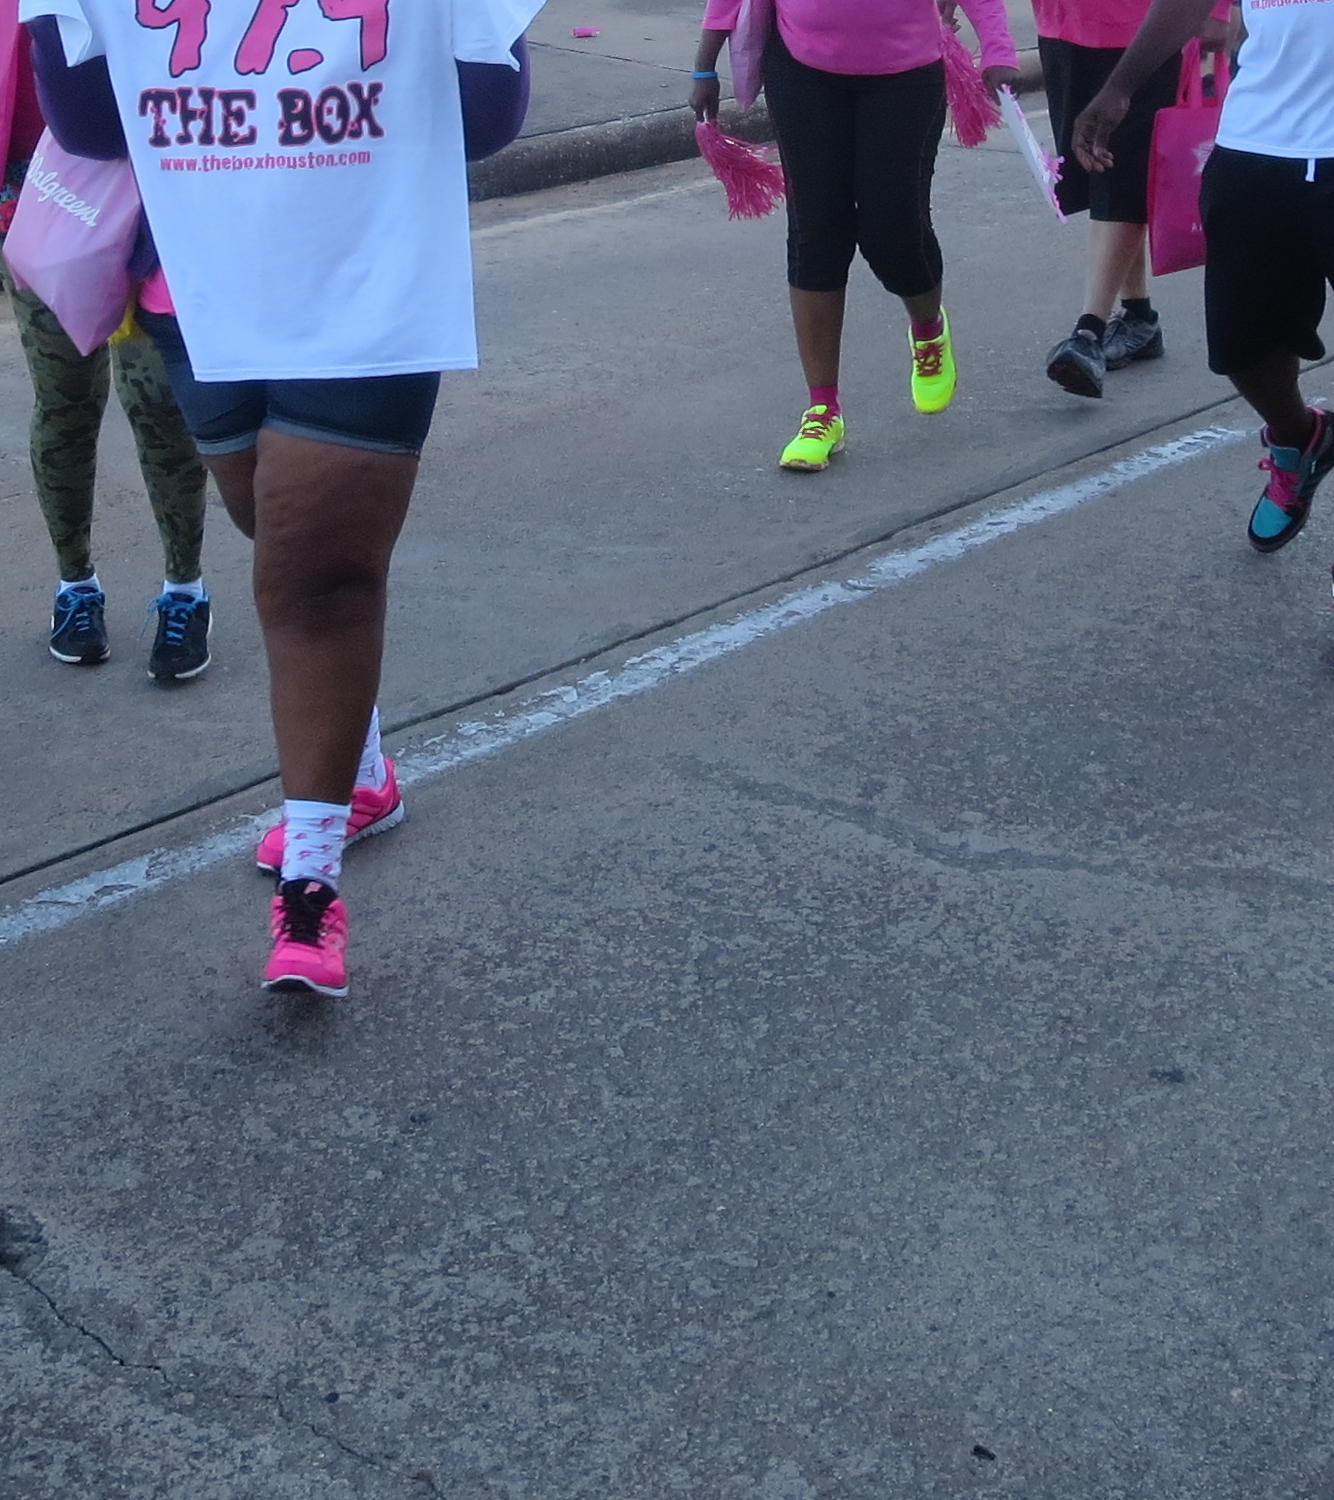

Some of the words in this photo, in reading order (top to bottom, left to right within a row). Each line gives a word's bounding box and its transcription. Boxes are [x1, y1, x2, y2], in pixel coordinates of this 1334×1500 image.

[138, 86, 258, 149] THE
[276, 81, 385, 147] BOX
[160, 150, 371, 173] www.theboxhouston.com
